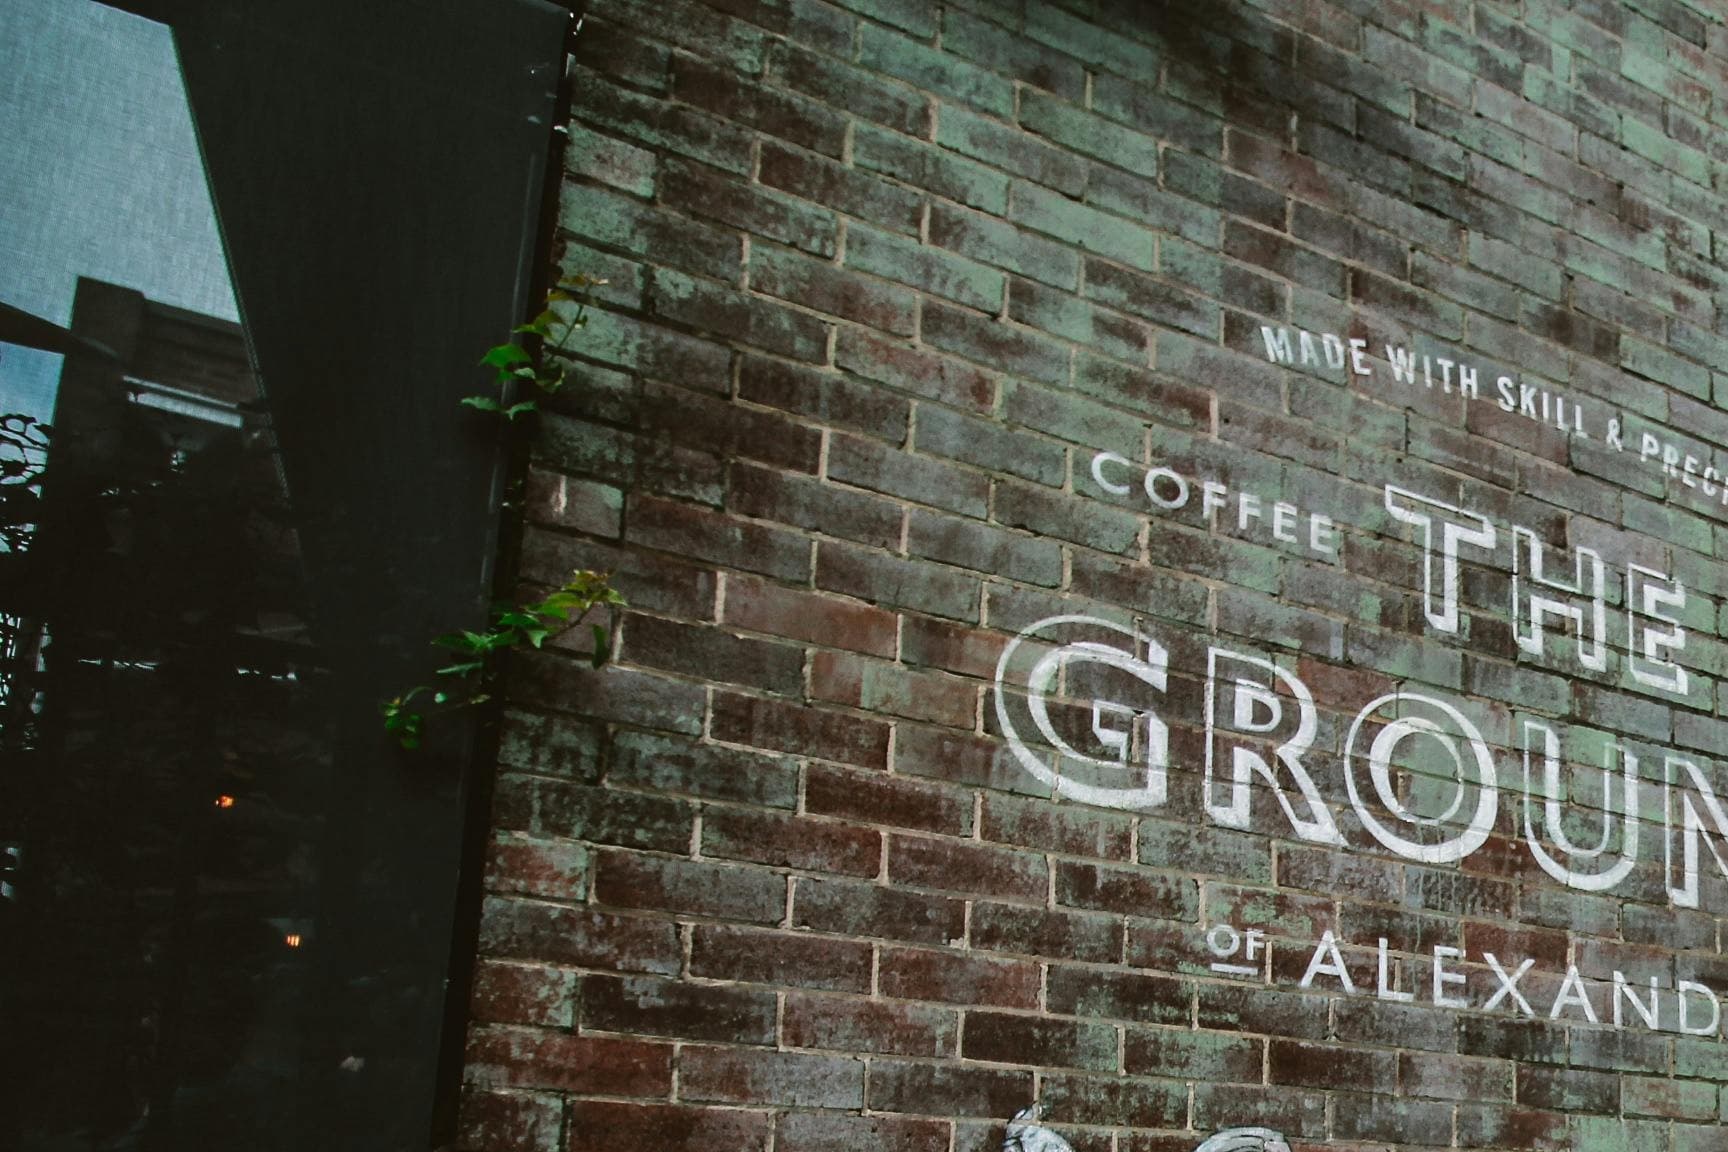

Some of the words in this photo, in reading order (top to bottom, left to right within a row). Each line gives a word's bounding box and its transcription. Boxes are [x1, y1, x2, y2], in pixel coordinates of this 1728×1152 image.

[1260, 325, 1372, 378] MADE
[1385, 344, 1479, 400] WITH
[1497, 376, 1588, 439] SKILL
[1606, 418, 1623, 453] &
[1091, 451, 1336, 554] COFFEE
[1385, 484, 1689, 696] THE
[1206, 924, 1265, 960] OF
